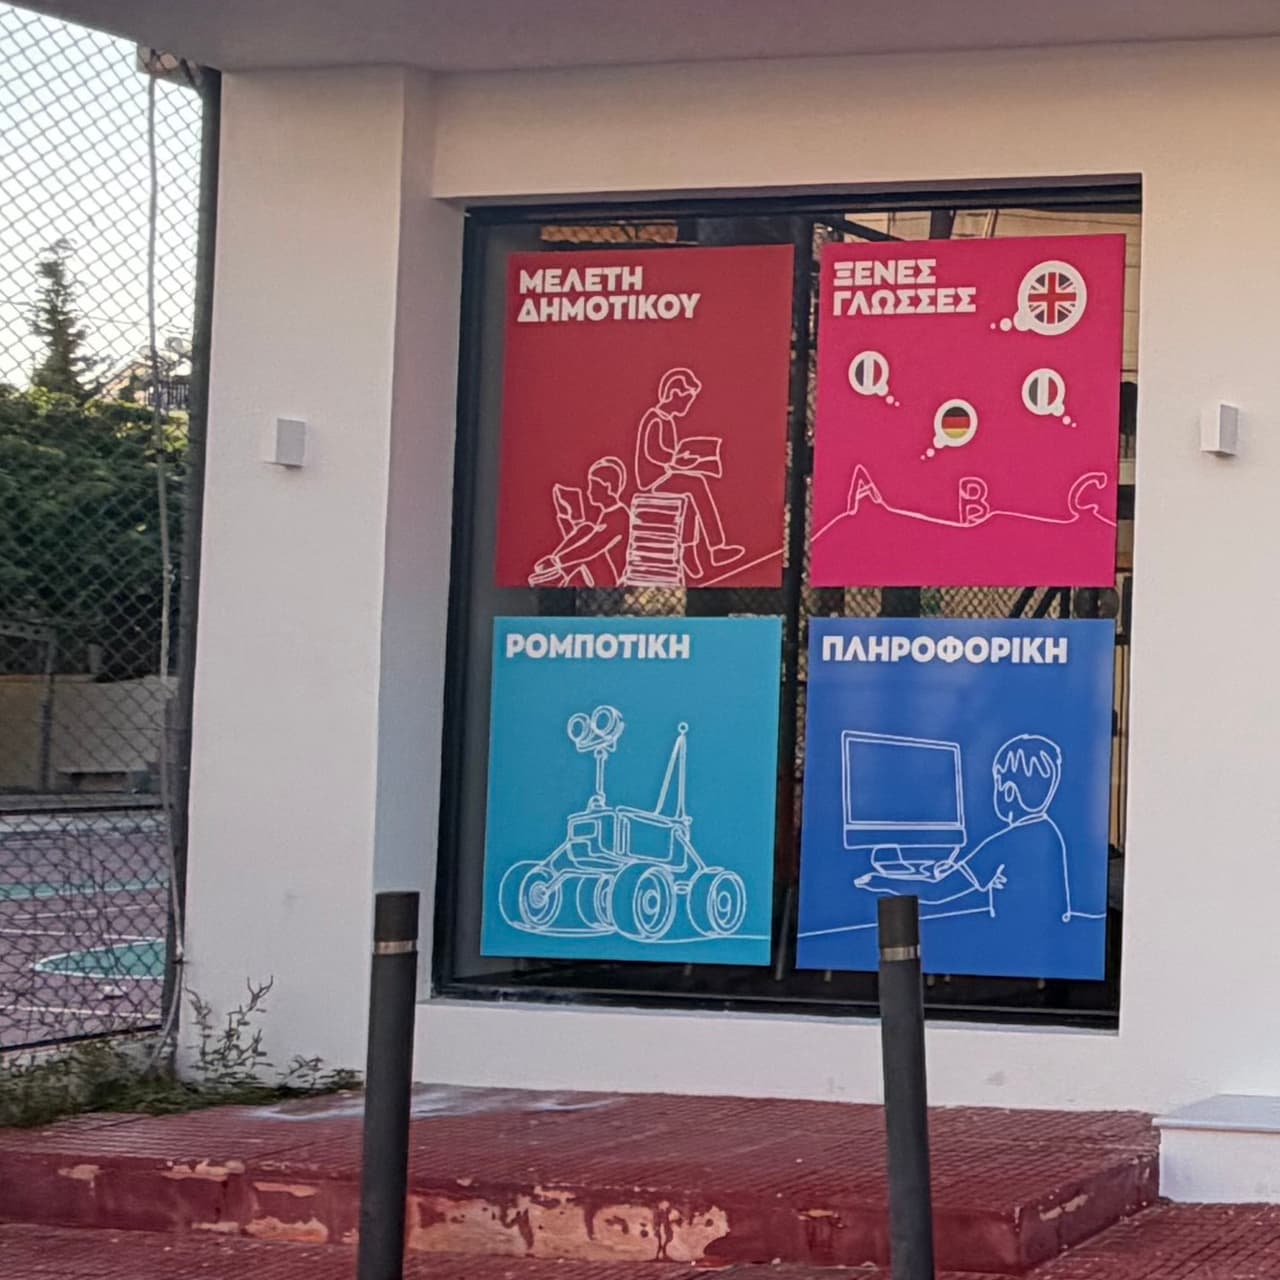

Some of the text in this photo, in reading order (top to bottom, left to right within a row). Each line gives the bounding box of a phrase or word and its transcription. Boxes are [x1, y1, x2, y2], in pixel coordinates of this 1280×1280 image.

[519, 265, 643, 294] ΜΕΛΕΤΗ
[833, 258, 937, 287] ΞΕΝΕΣ
[517, 292, 701, 323] ΔΗΜΟΤΙΚΟΥ
[832, 286, 977, 316] ΓΛΩΣΣΕΣ
[506, 632, 691, 660] ΡΟΜΠΟΤΙΚΗ
[822, 635, 1068, 665] ΠΛΗΡΟΦΟΡΙΚΗ
